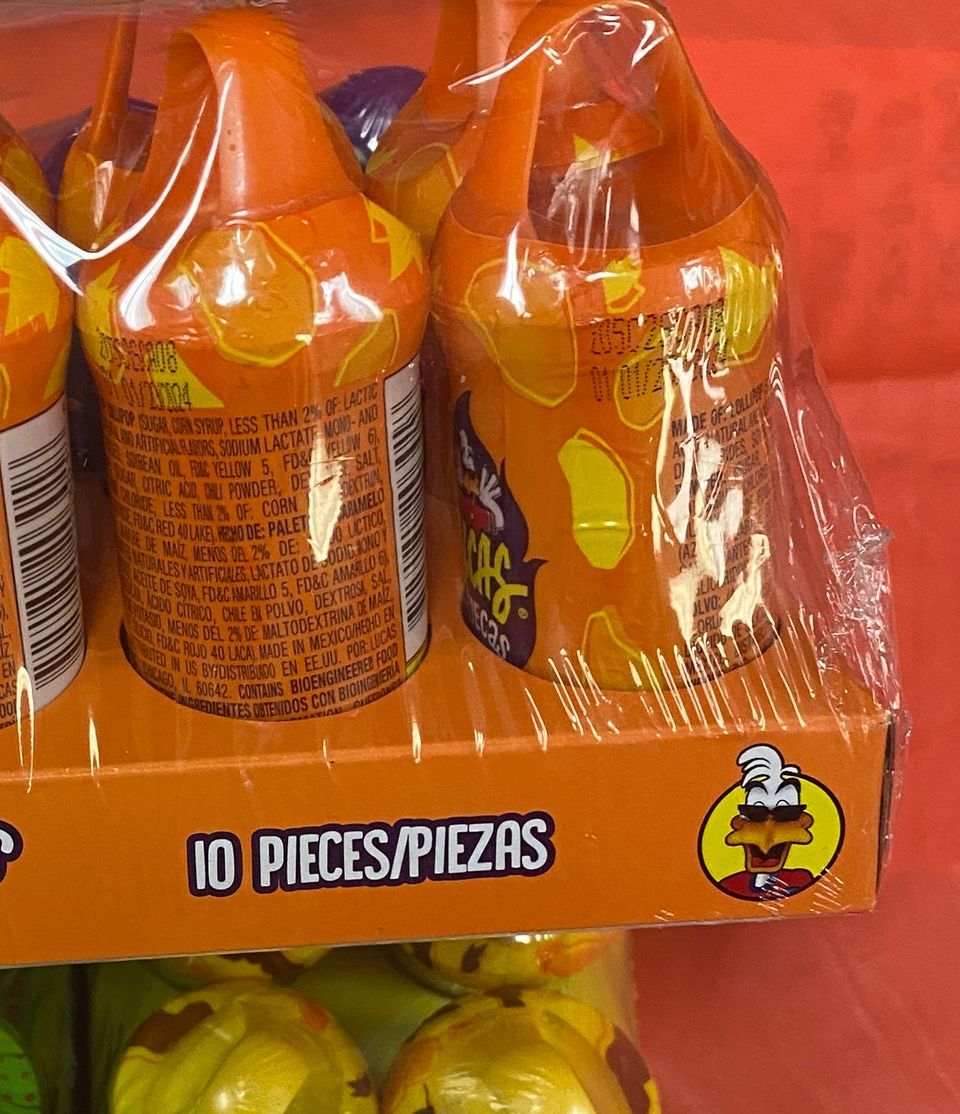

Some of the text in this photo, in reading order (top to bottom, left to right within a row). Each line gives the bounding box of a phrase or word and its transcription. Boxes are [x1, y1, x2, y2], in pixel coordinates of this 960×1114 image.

[230, 382, 378, 436] LESS THAN LACTIC
[220, 404, 378, 457] SODIUM AND
[212, 460, 252, 479] YELLOW
[230, 478, 282, 500] POWDER,
[164, 496, 298, 519] LESS CORN
[156, 520, 265, 540] RED DE:
[193, 544, 270, 562] MENOS 2%
[250, 558, 299, 581] LACTATO
[160, 578, 172, 596] DE
[202, 586, 230, 602] FD&C
[232, 582, 276, 602] AMARILLO
[296, 572, 329, 594] FD&C
[168, 604, 354, 642] MENOS DEL MALTODEXTRINA
[222, 606, 248, 622] CHILE
[266, 598, 308, 620] POLVO,
[157, 632, 180, 654] FD&C
[184, 640, 206, 660] ROJO
[211, 646, 225, 660] 40
[259, 641, 289, 660] MADE
[292, 639, 305, 656] IN
[171, 656, 180, 672] IN
[186, 660, 198, 676] US
[282, 659, 298, 676] EN
[304, 650, 342, 672] EE.UU.
[370, 623, 396, 650] LUCAS
[2, 660, 17, 678] EN
[196, 680, 232, 699] 60642.
[238, 682, 284, 700] CONTAINS
[290, 656, 374, 694] BIOENGINEERED
[376, 642, 398, 668] FOOD
[253, 696, 308, 718] OBTENIDOS
[311, 688, 336, 710] CON
[194, 818, 549, 890] 10 PIECES/PIEZAS
